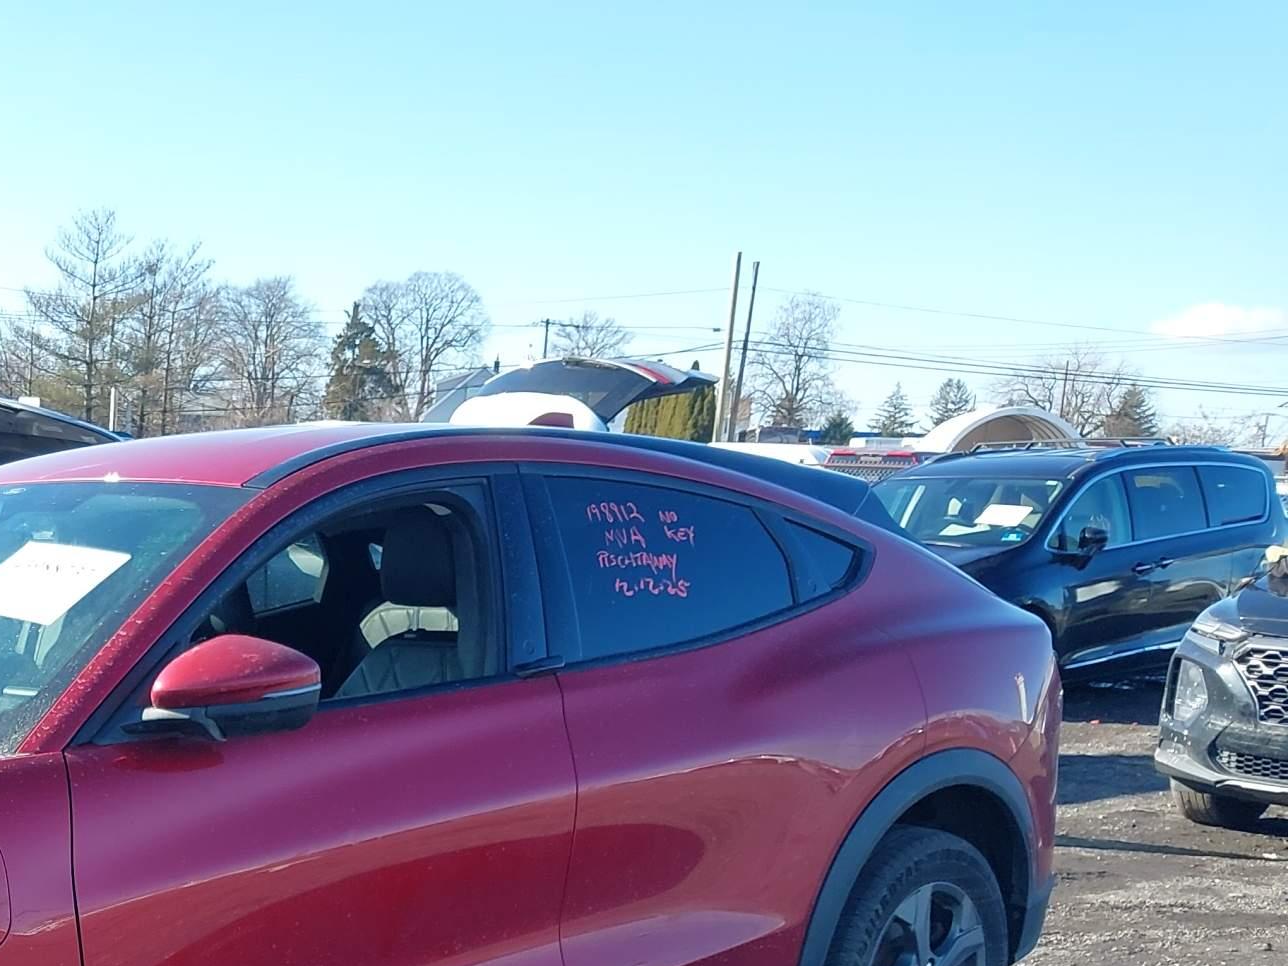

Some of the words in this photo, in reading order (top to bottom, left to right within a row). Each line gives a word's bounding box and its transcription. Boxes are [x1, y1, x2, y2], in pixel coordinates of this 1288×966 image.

[586, 502, 645, 523] 198912
[658, 510, 679, 523] NO
[663, 525, 695, 547] KEY
